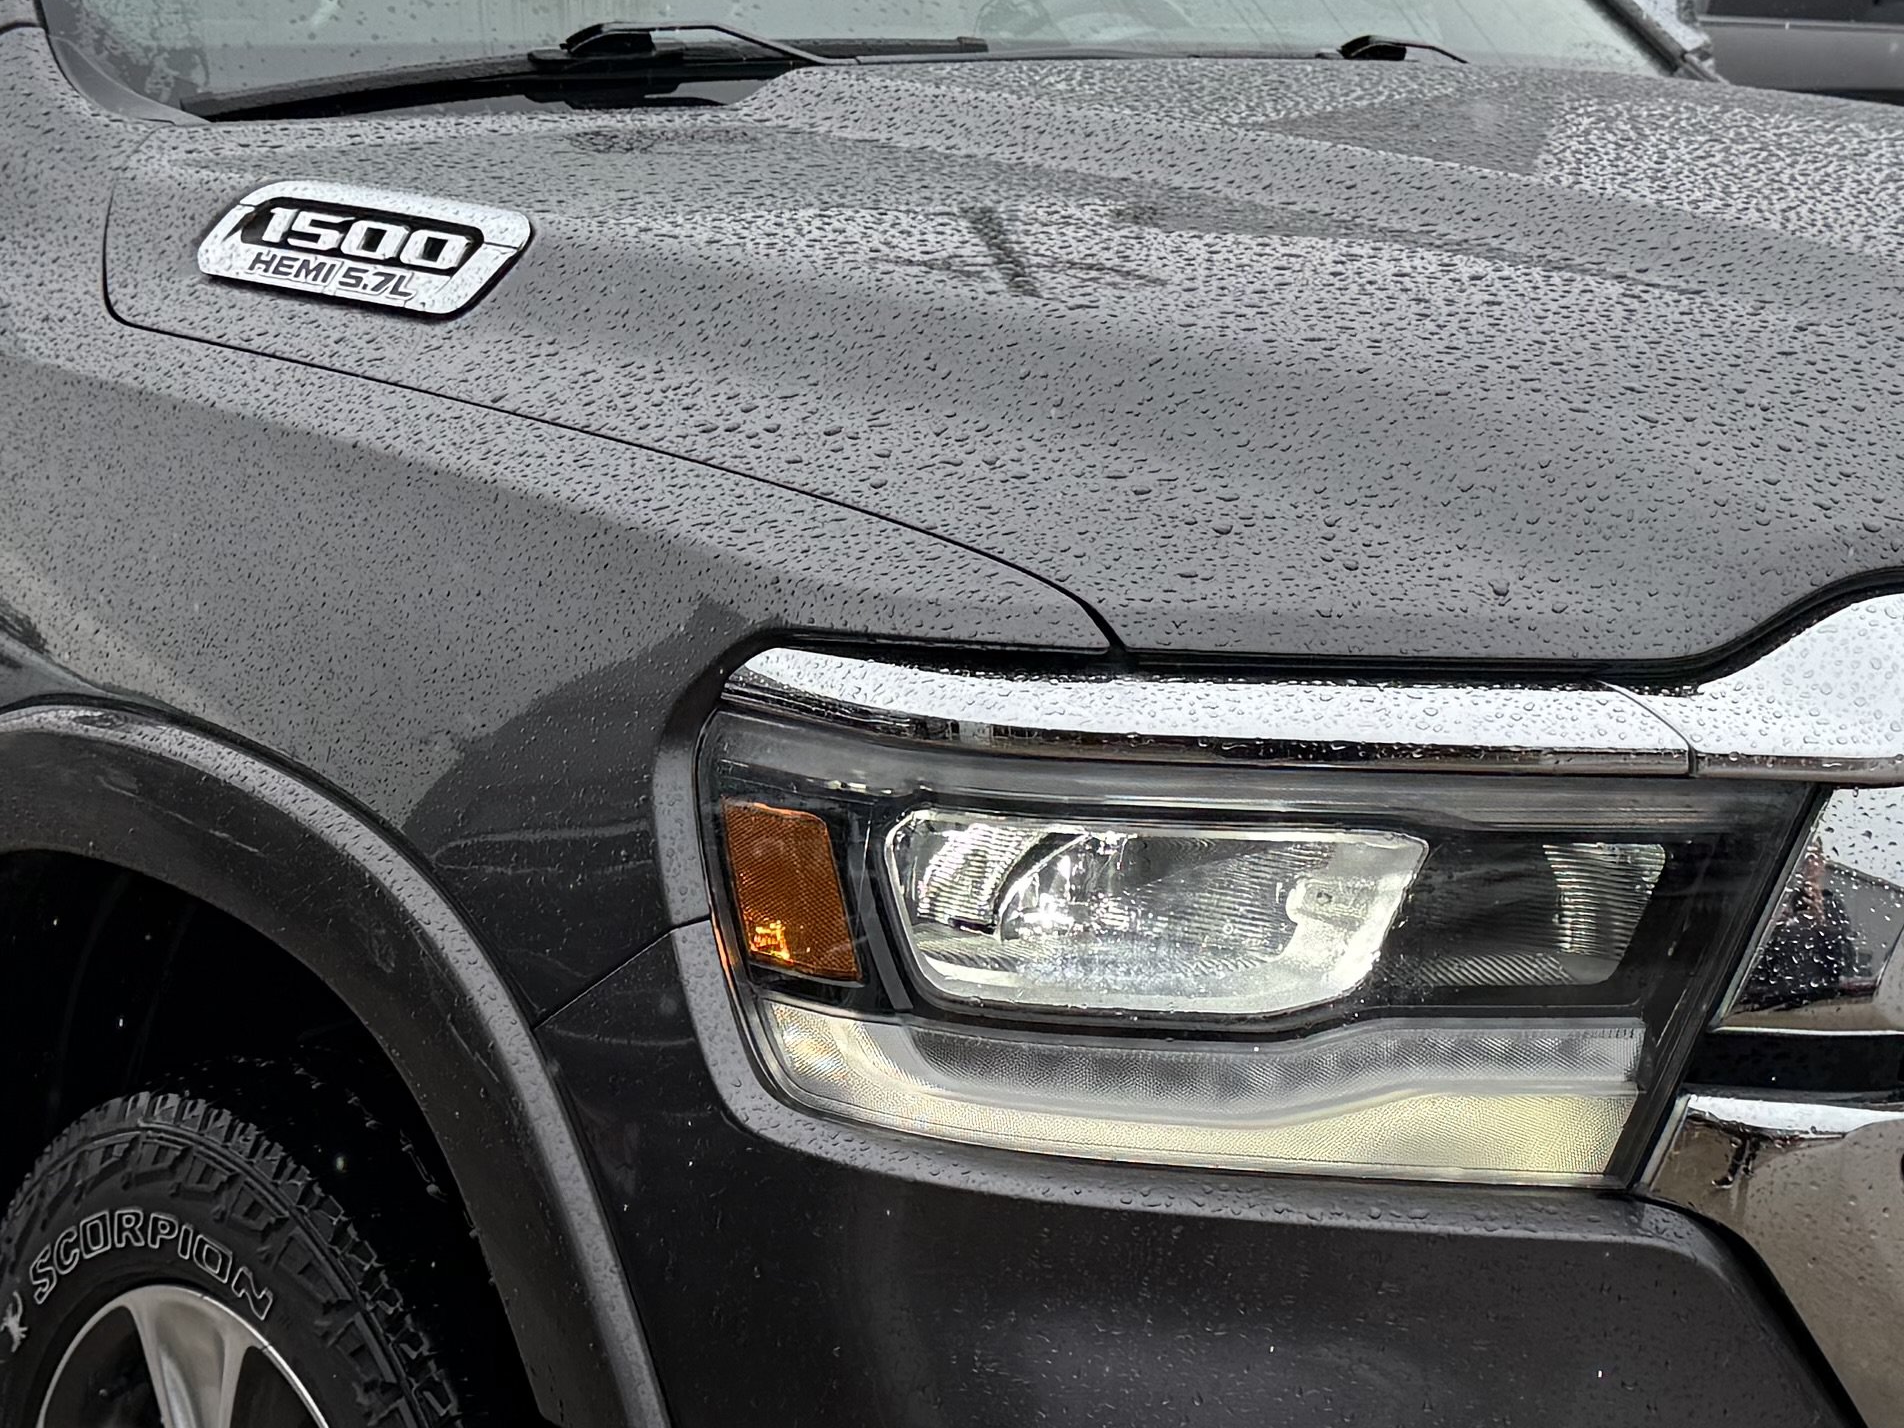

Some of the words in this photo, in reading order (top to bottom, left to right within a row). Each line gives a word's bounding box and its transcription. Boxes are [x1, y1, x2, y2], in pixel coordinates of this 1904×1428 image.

[262, 207, 473, 269] 1500
[248, 251, 334, 283] HEMI
[338, 266, 417, 300] 5.7L
[30, 1206, 273, 1320] SCORPION
